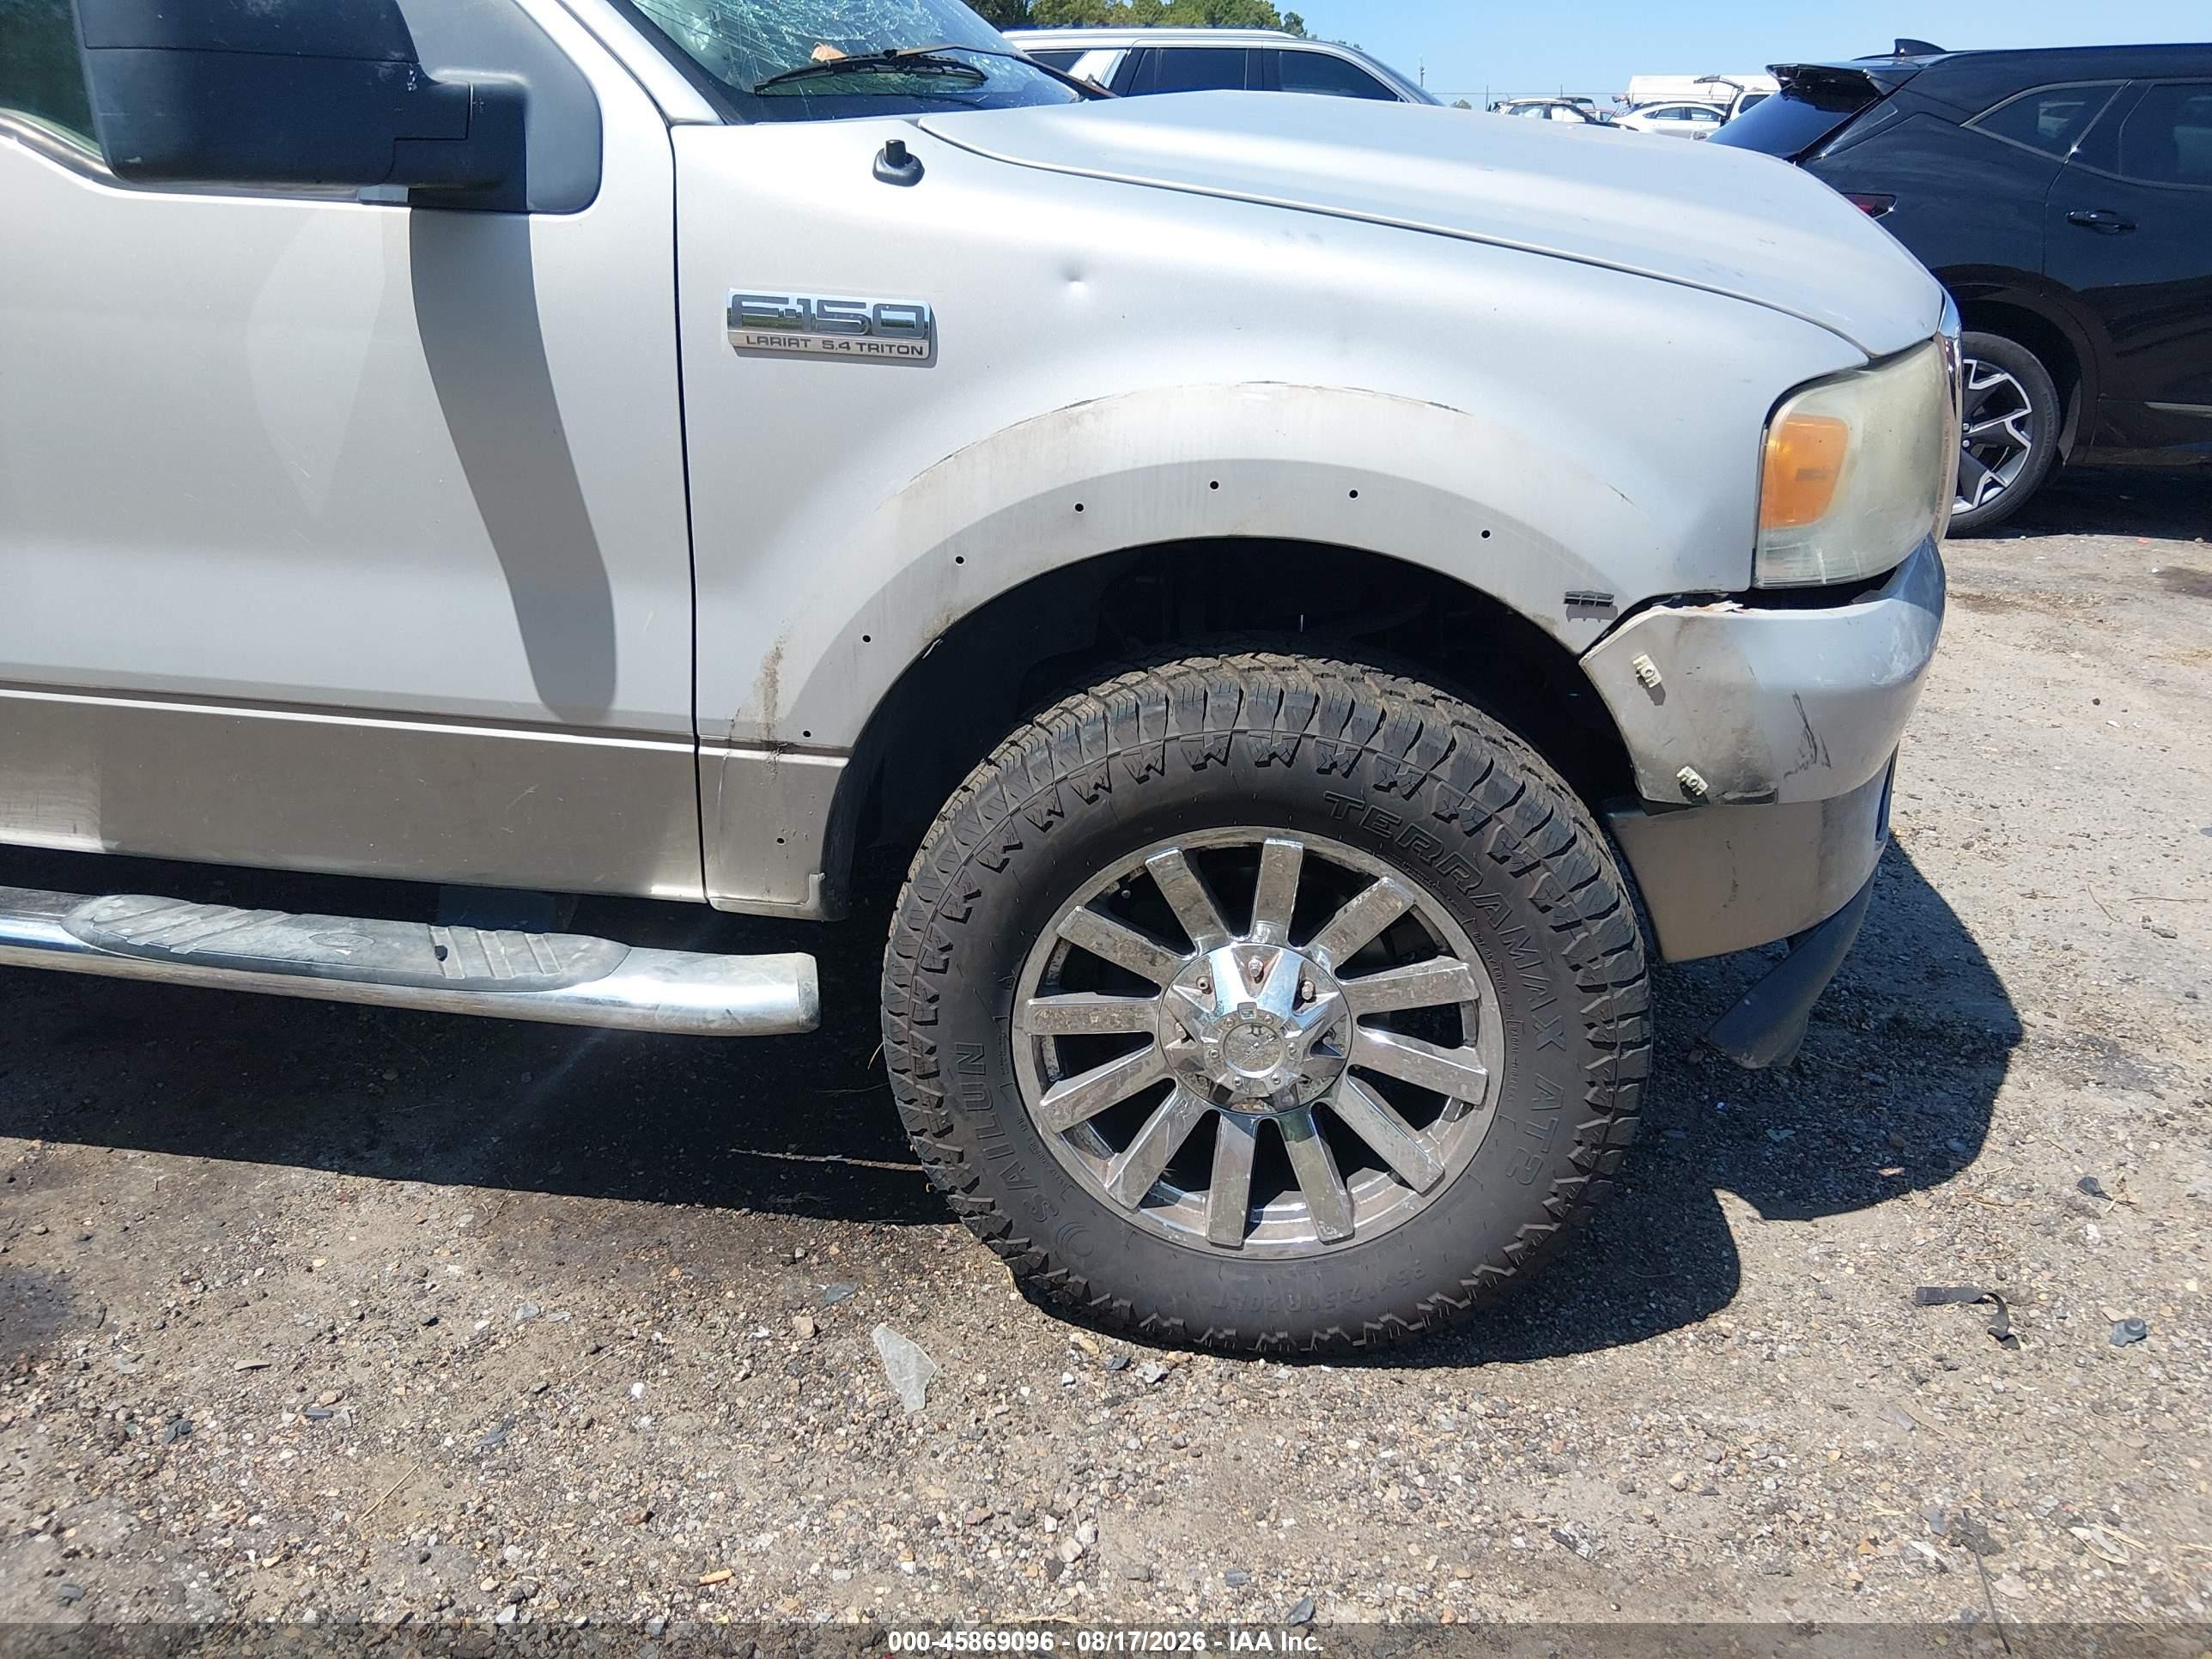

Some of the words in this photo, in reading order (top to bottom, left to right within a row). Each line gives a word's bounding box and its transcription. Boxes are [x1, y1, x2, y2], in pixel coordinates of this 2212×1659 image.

[731, 294, 926, 339] F-150
[745, 334, 811, 349] LARIAT
[822, 340, 851, 351] 5.4
[855, 341, 924, 356] TRITON
[1323, 790, 1568, 1051] TERRAMAX
[954, 1042, 1059, 1223] SAILUN
